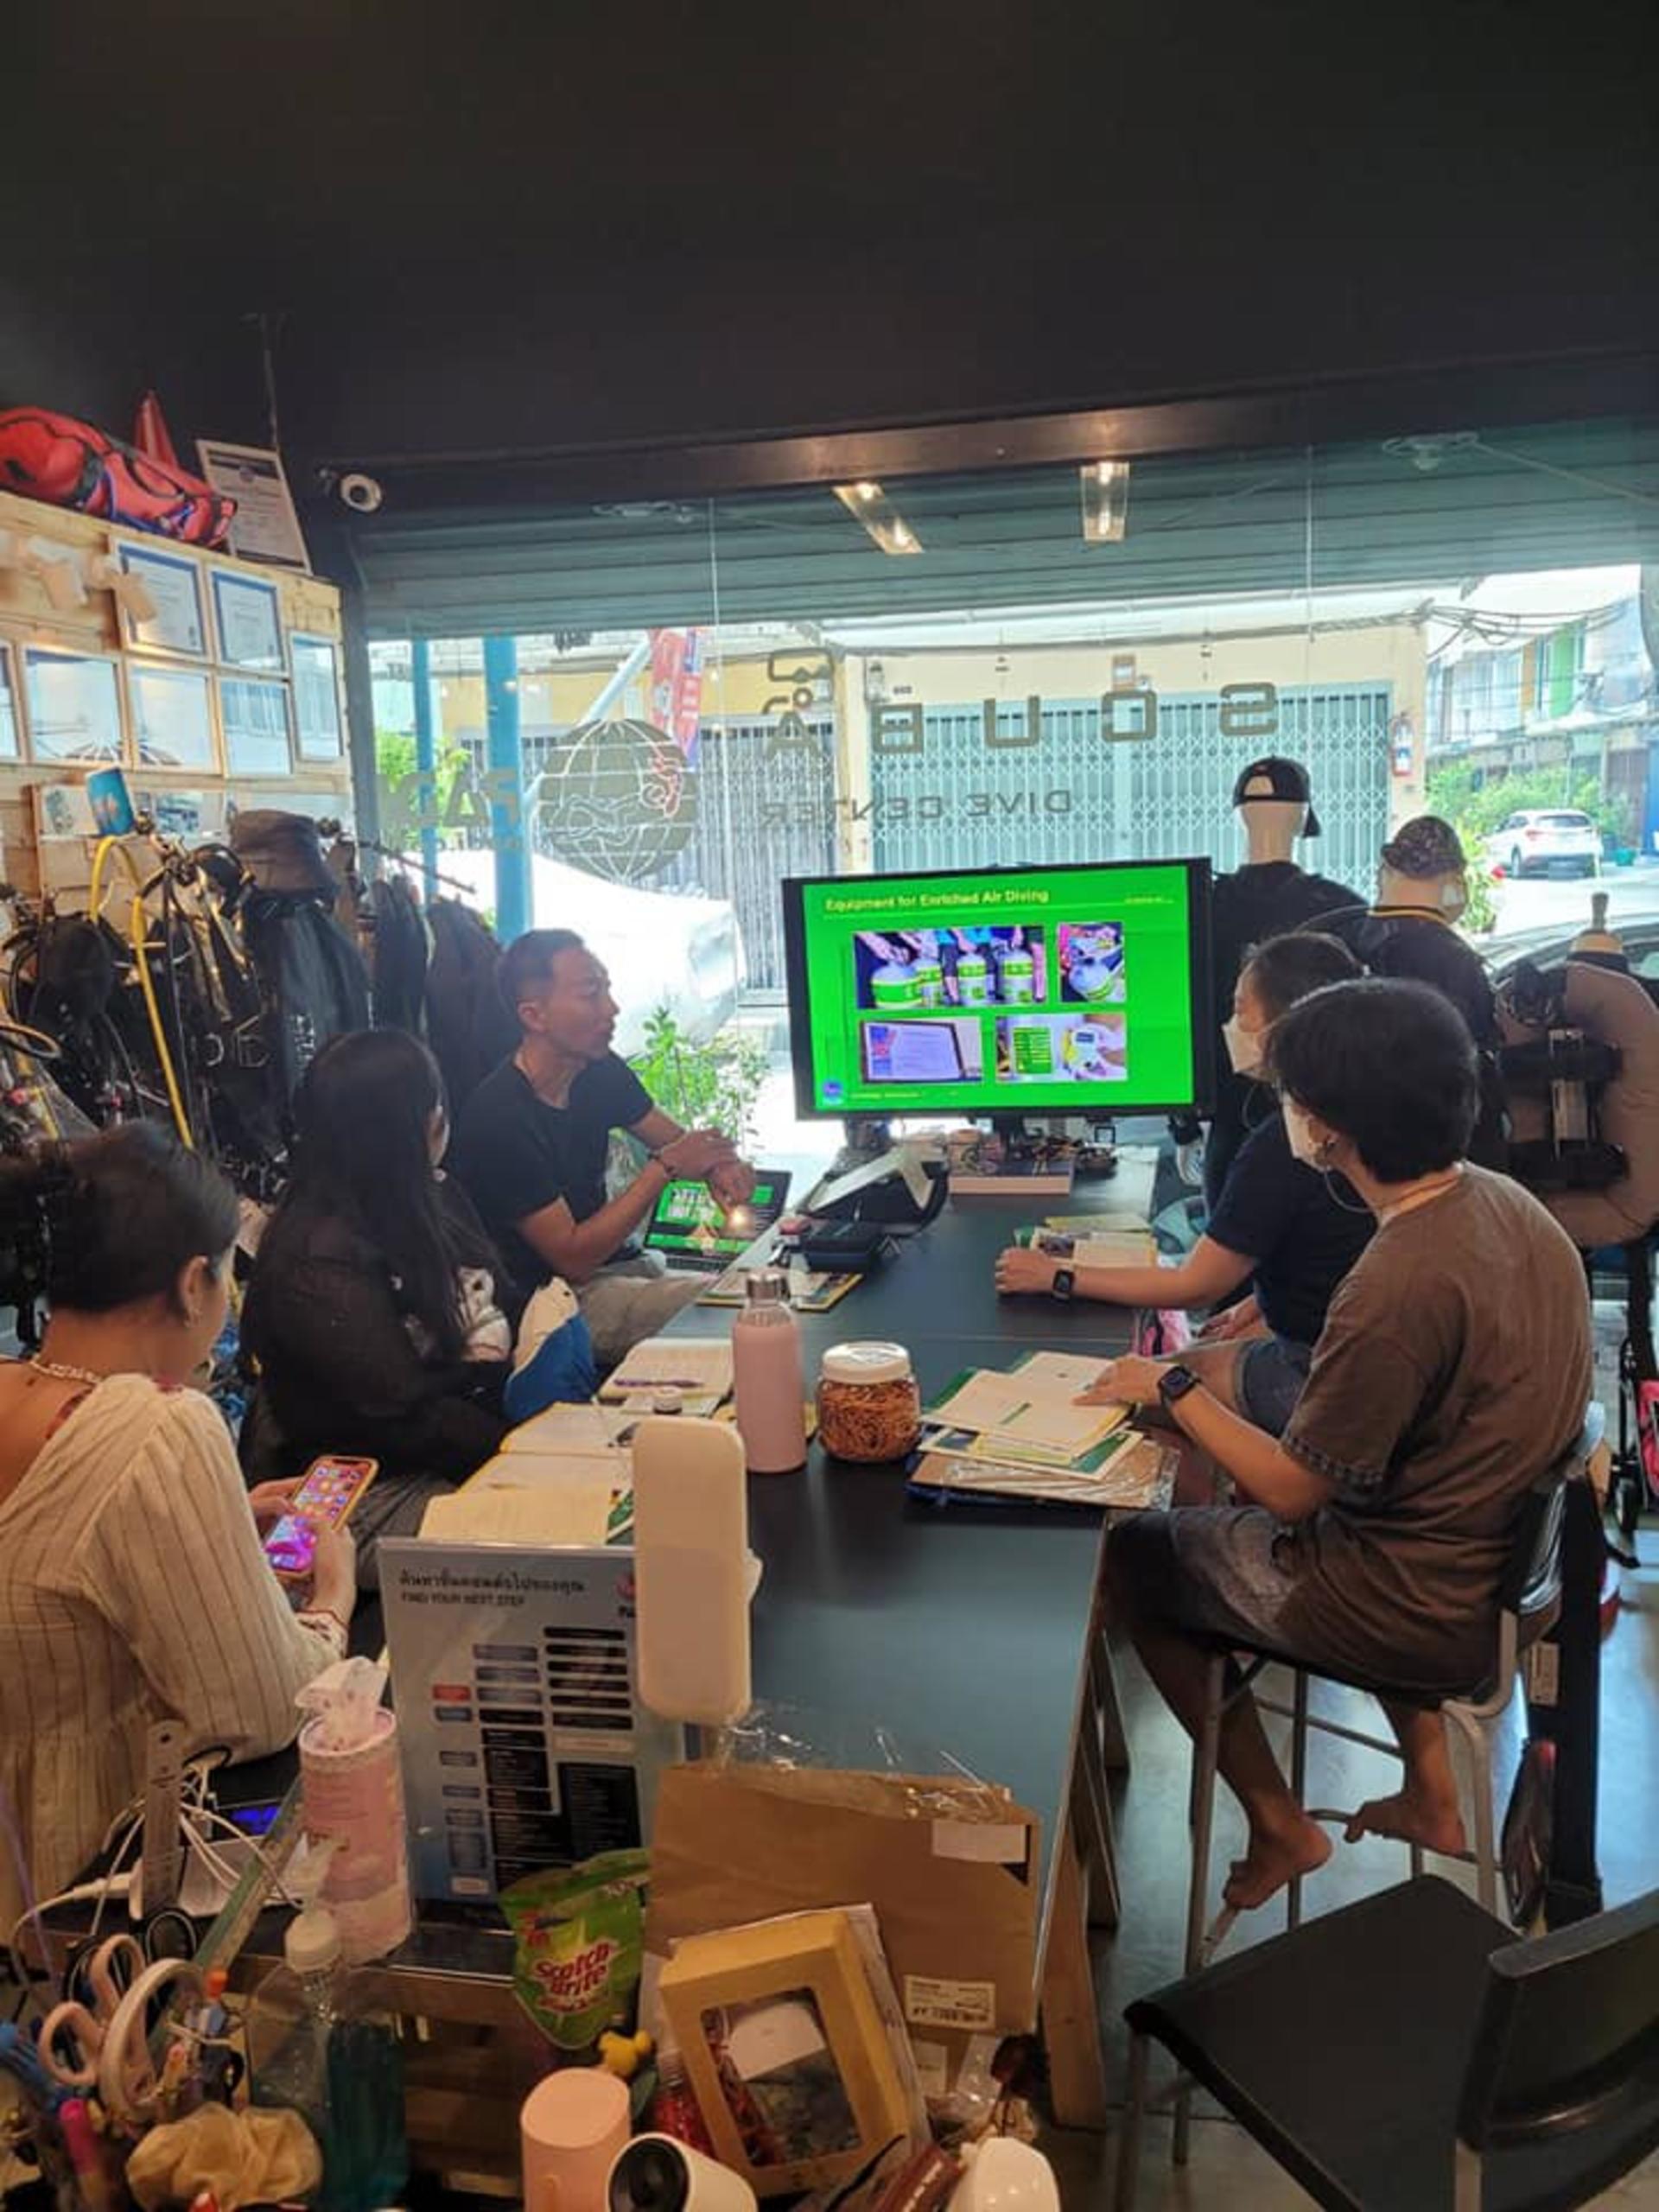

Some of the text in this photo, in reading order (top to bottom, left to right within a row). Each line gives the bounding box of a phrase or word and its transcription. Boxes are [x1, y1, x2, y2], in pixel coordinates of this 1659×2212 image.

[826, 890, 1050, 912] Equipment for Enriched Air Diving
[535, 1942, 611, 1979] Scotch
[551, 1964, 607, 1996] Brite
